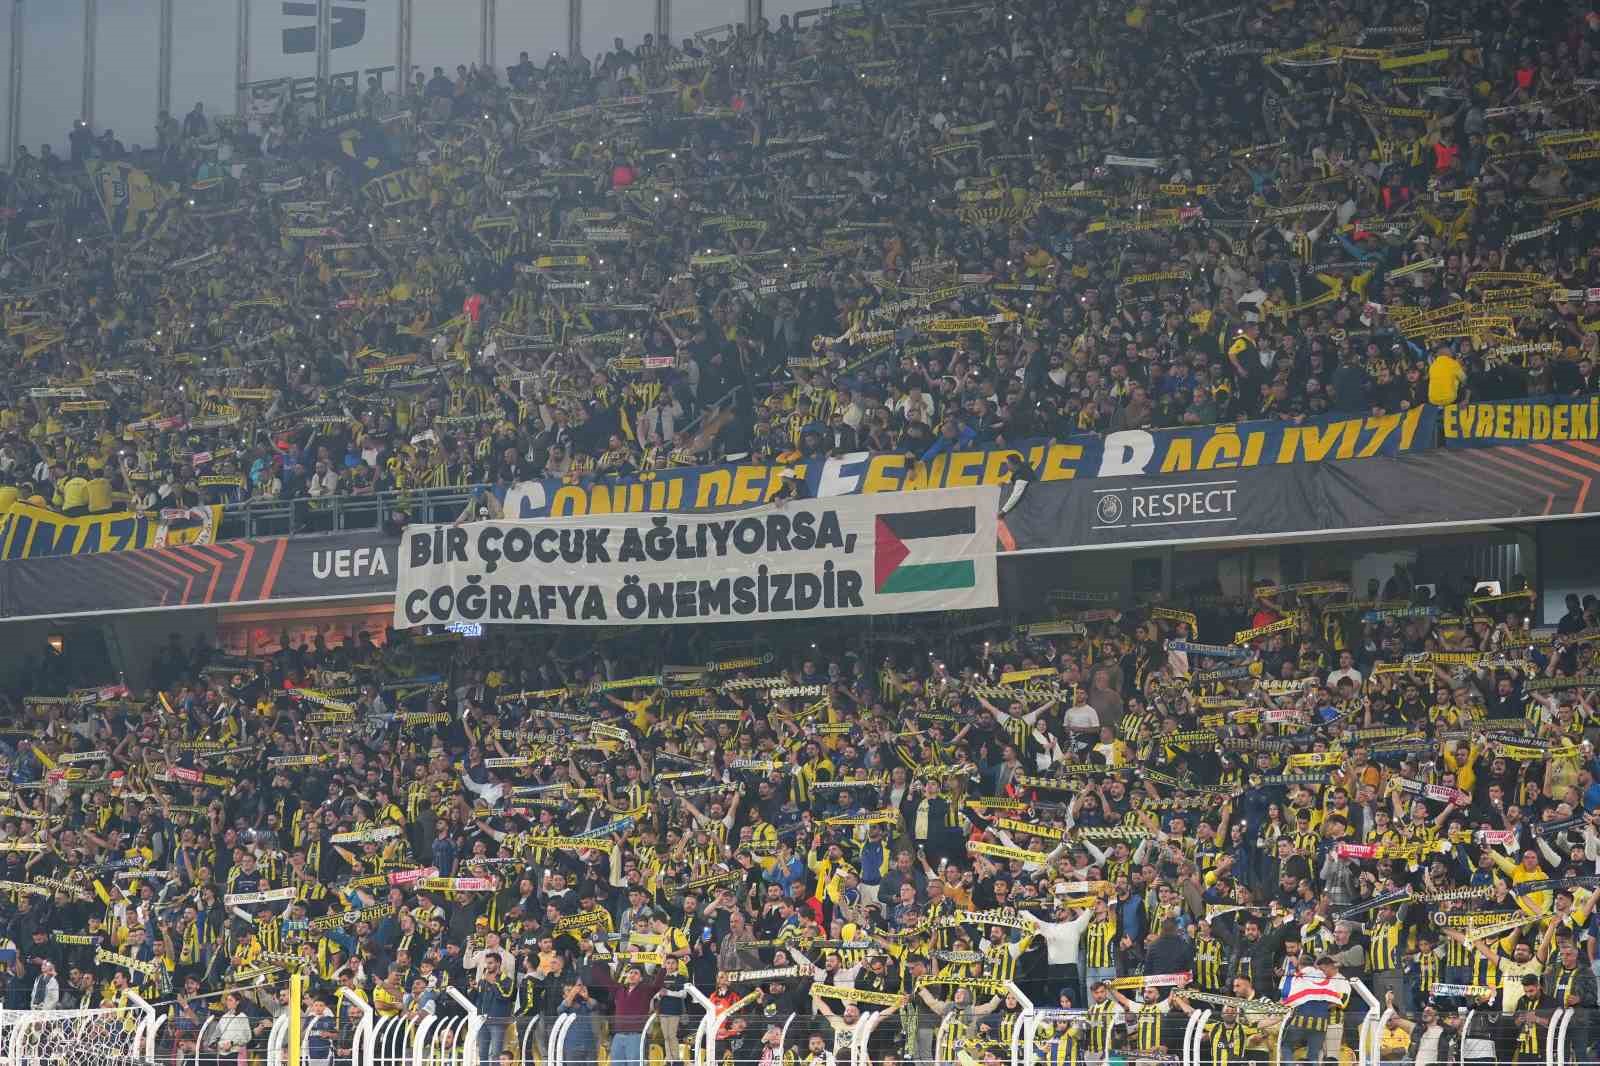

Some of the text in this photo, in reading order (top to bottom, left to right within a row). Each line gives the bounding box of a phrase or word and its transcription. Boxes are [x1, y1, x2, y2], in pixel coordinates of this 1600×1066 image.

[1131, 490, 1237, 518] RESPECT
[311, 548, 389, 579] UEFA
[410, 511, 857, 574] BİR ÇOCUK AĞLIYORSA,
[616, 559, 865, 620] ÖNEMSİZDİR
